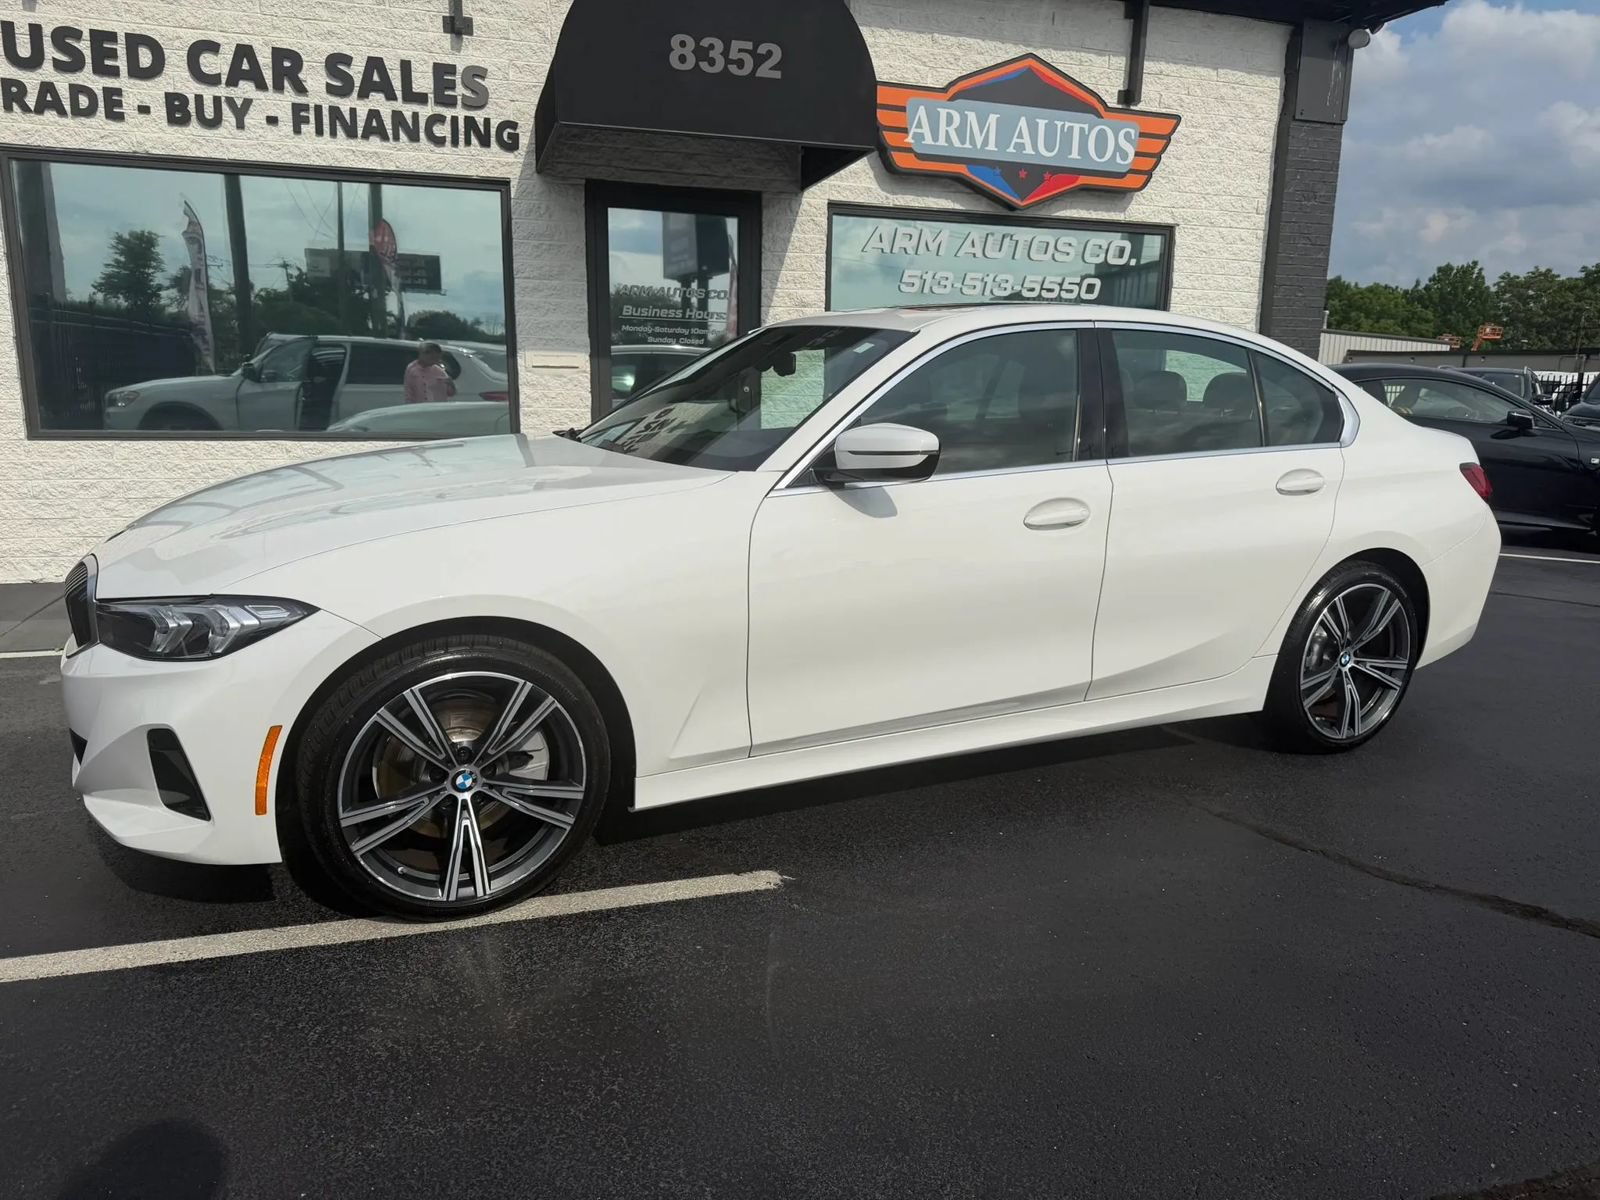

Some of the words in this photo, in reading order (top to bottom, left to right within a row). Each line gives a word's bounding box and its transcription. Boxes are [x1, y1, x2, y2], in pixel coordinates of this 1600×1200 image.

[1, 20, 166, 80] USED
[186, 39, 310, 93] CAR
[324, 52, 490, 108] SALES
[669, 33, 782, 79] 8352
[0, 77, 126, 122] RADE
[164, 92, 254, 130] BUY
[291, 102, 521, 151] FINANCING
[904, 105, 1001, 152] ARM
[1006, 116, 1136, 166] AUTOS
[862, 225, 948, 257] ARM
[954, 231, 1075, 264] AUTOS
[1081, 238, 1138, 266] CO.
[620, 284, 652, 297] ARM
[654, 286, 706, 299] AUTOS
[622, 305, 683, 318] Business
